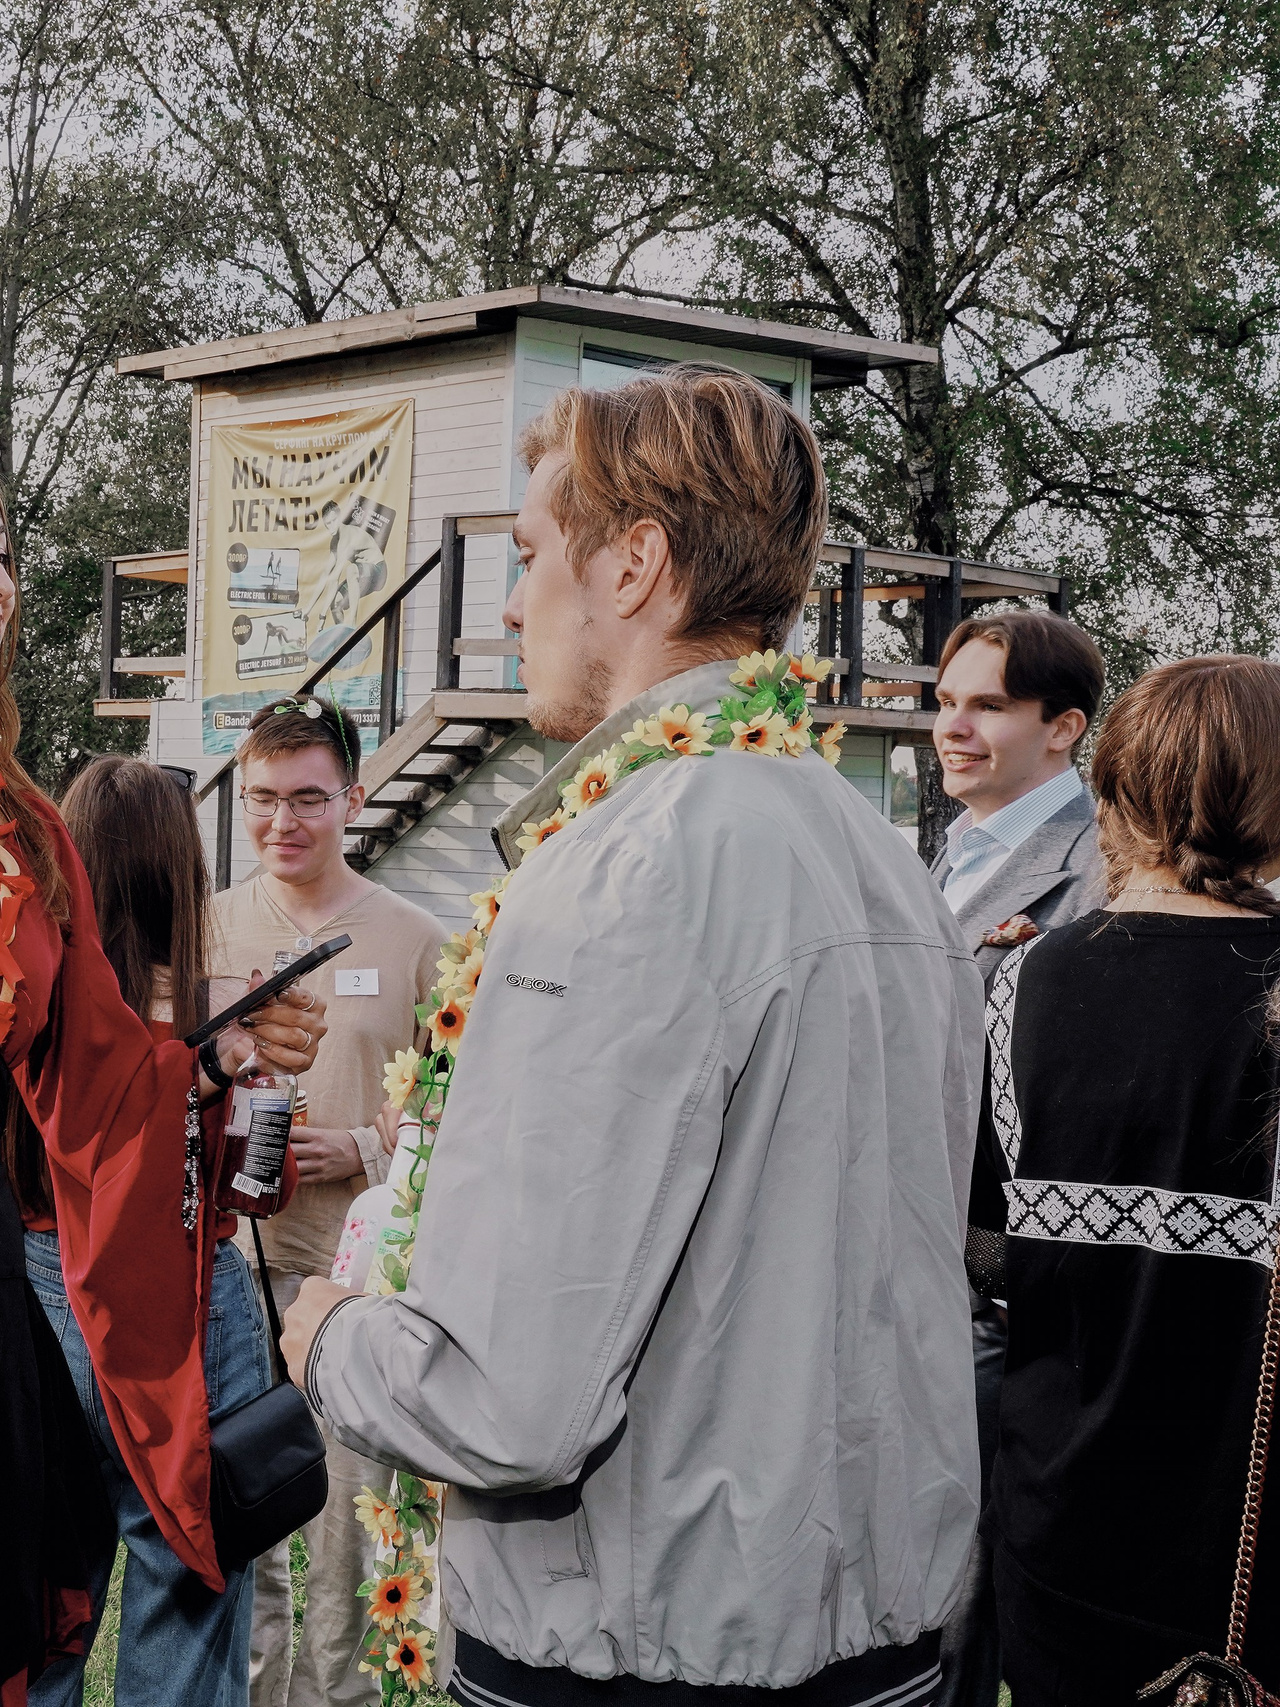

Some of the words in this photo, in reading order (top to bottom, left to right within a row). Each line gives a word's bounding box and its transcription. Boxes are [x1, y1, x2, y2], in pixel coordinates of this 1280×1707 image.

[274, 437, 310, 450] СЕРФИНГ
[312, 435, 325, 448] НА
[326, 431, 368, 447] КРУГЛОМ
[231, 454, 274, 490] МЫ
[279, 445, 390, 488] НАУЧИМ
[228, 496, 319, 533] ЛЕТАТЬ
[230, 590, 252, 600] ELECTRIC
[252, 591, 266, 601] EFOIL
[239, 660, 260, 671] ELECTRIC
[260, 657, 283, 668] JETSURF
[353, 975, 361, 987] 2
[505, 972, 567, 998] GEOX
